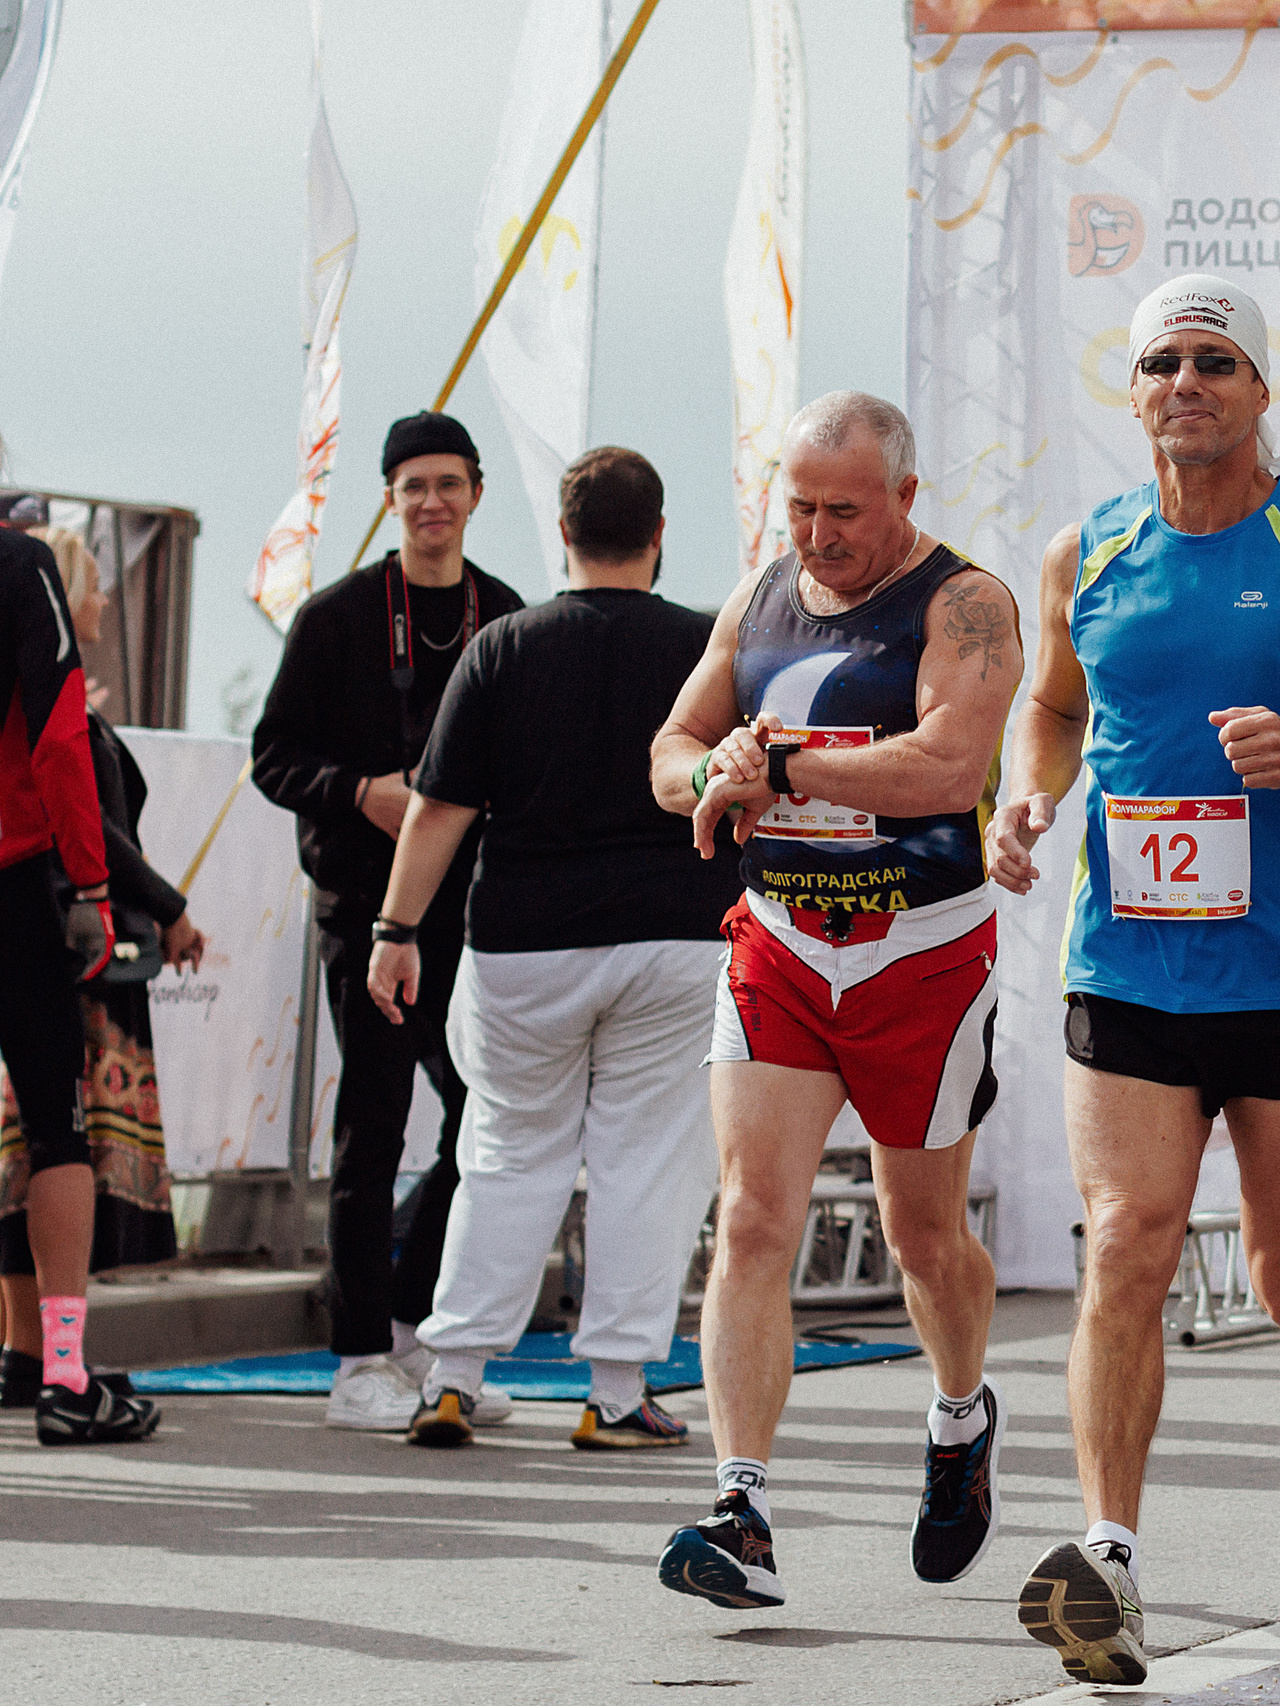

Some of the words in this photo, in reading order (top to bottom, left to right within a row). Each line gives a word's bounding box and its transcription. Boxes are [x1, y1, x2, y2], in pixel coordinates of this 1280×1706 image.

[1160, 293, 1218, 308] RedFox
[1163, 315, 1228, 330] ELBRUSRACE
[1110, 804, 1176, 815] ПОЛУМАРАФОН
[1139, 832, 1200, 883] 12
[762, 866, 907, 891] ВОЛГОГРАДСКАЯ
